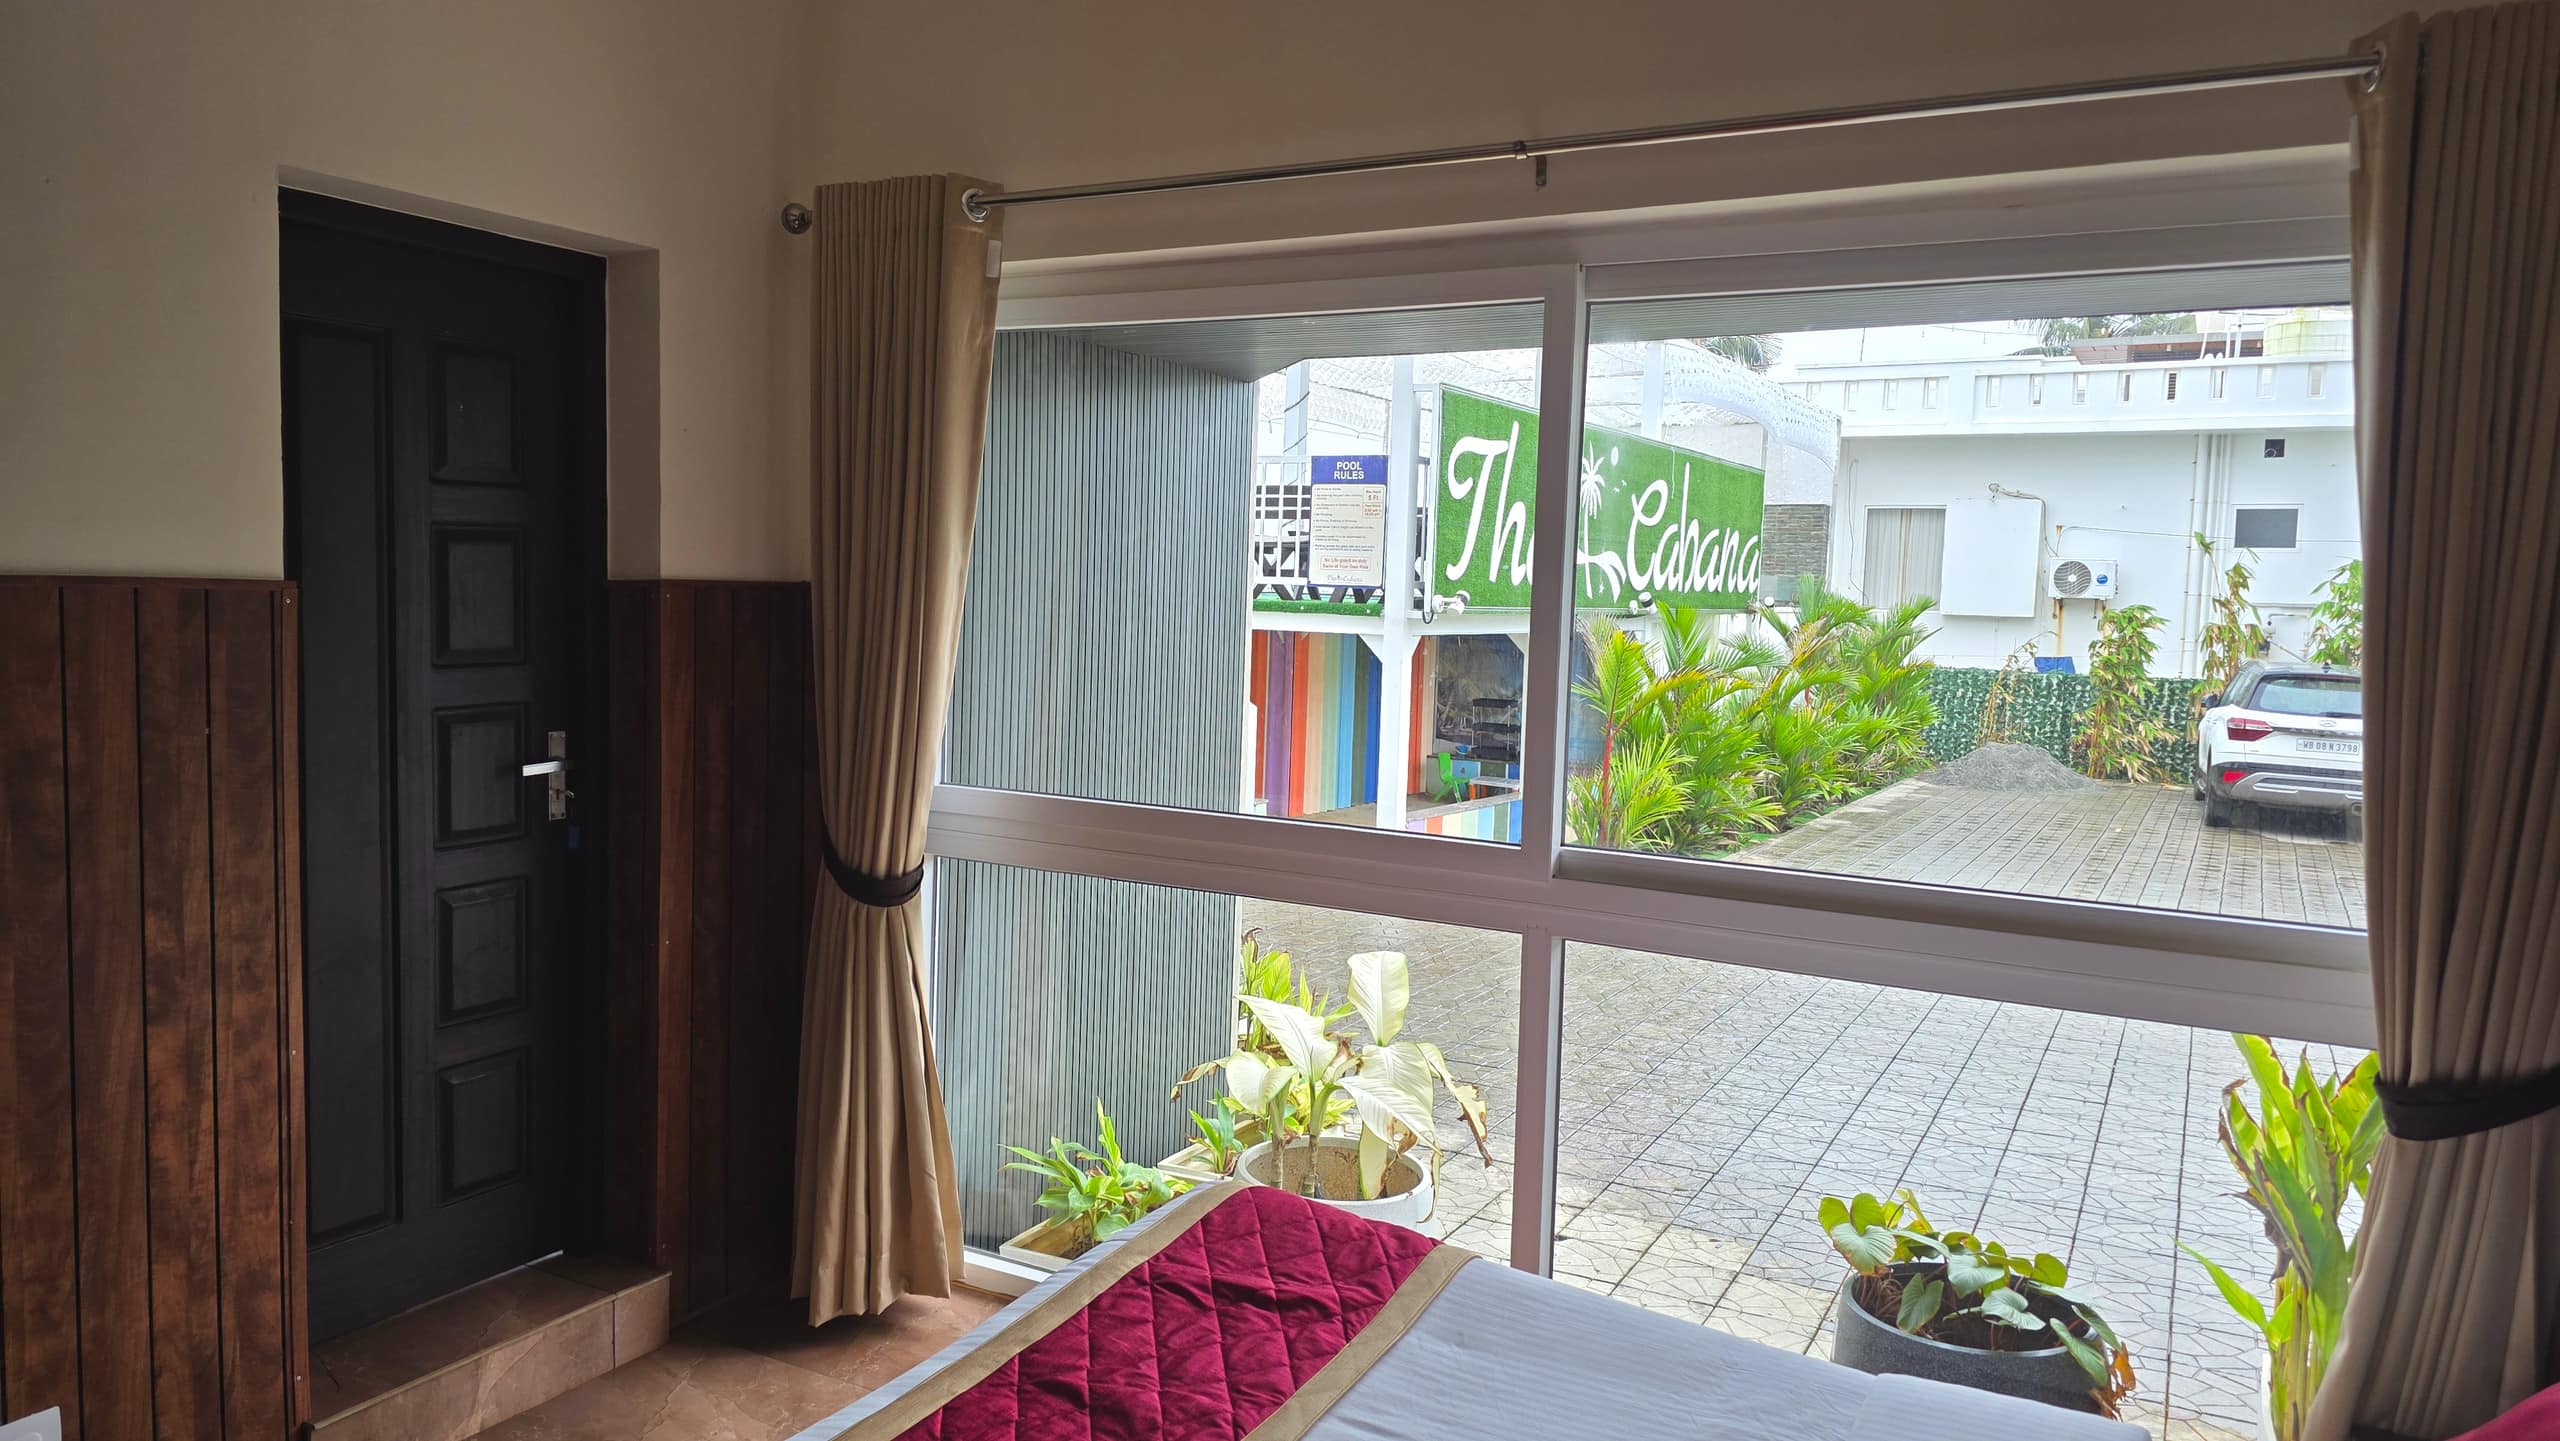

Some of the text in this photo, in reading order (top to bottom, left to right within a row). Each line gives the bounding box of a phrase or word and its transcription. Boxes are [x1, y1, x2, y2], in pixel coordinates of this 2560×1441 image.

[1336, 461, 1362, 470] POOL
[1334, 471, 1364, 480] RULES
[1446, 420, 1760, 593] Th Cabana
[2303, 741, 2314, 750] WB
[2336, 743, 2358, 752] 3798
